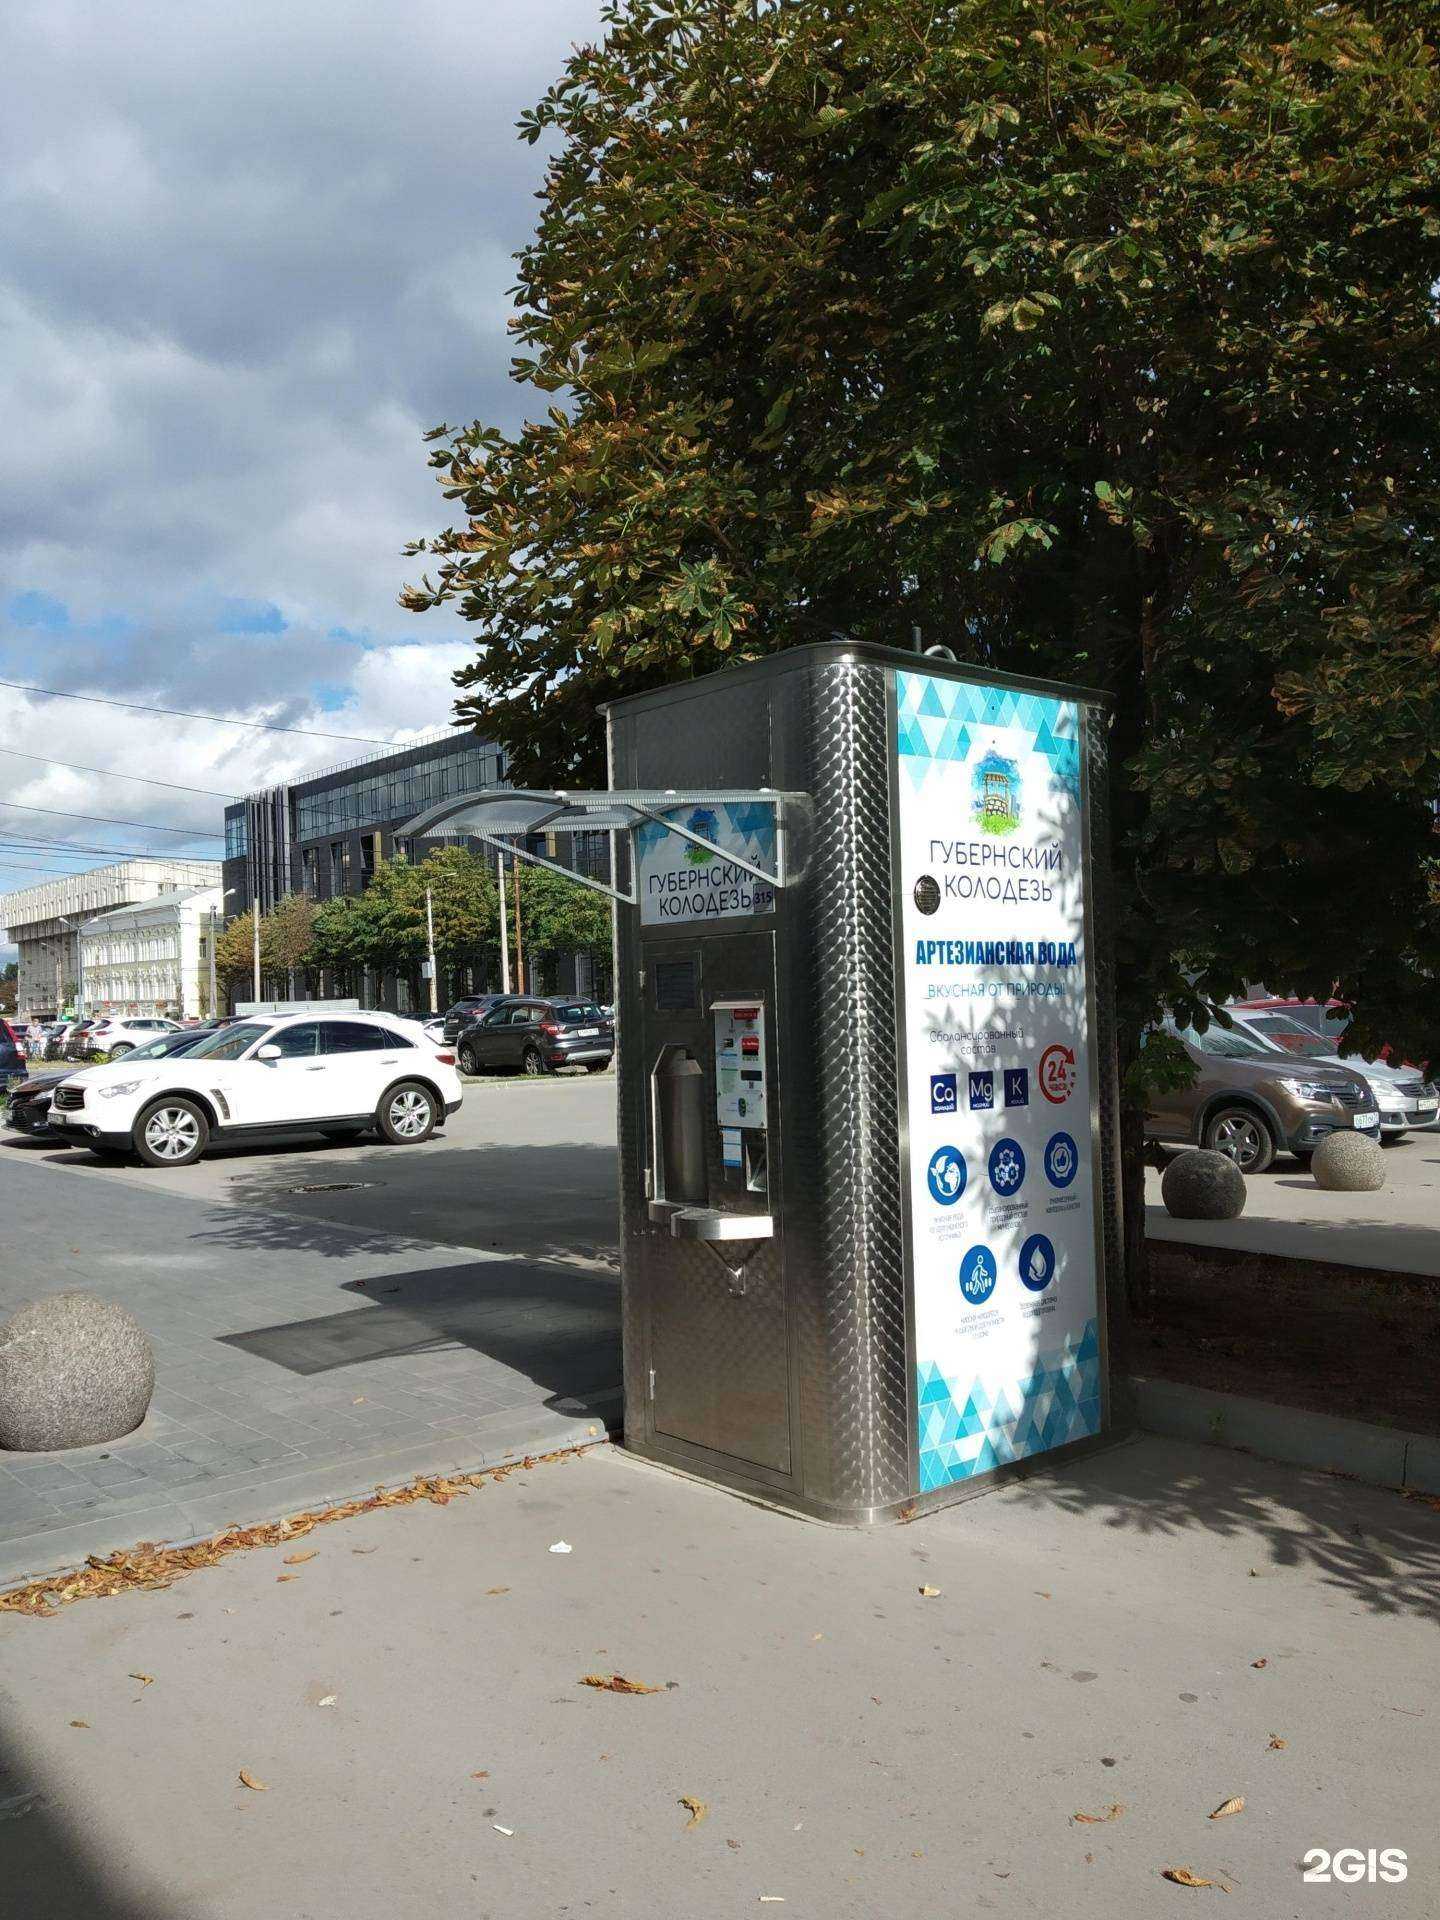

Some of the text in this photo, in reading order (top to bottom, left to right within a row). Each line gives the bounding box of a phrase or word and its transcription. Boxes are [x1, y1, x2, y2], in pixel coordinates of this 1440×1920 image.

[930, 840, 1062, 871] ГУБЕРНСКИЙ
[752, 891, 773, 905] 315
[944, 874, 1053, 904] КОЛОДЕЗЬ
[659, 888, 752, 917] КОЛОДЕЗЬ
[916, 940, 1077, 969] АРТЕЗИАНСКАЯ ВОДА
[928, 983, 985, 998] ВКУСНАЯ
[987, 982, 1004, 997] ОТ
[929, 1028, 1025, 1043] Сбалансированный
[960, 1044, 997, 1056] состав
[1048, 1060, 1067, 1082] 24
[933, 1082, 954, 1103] Ca
[970, 1078, 993, 1101] Mg
